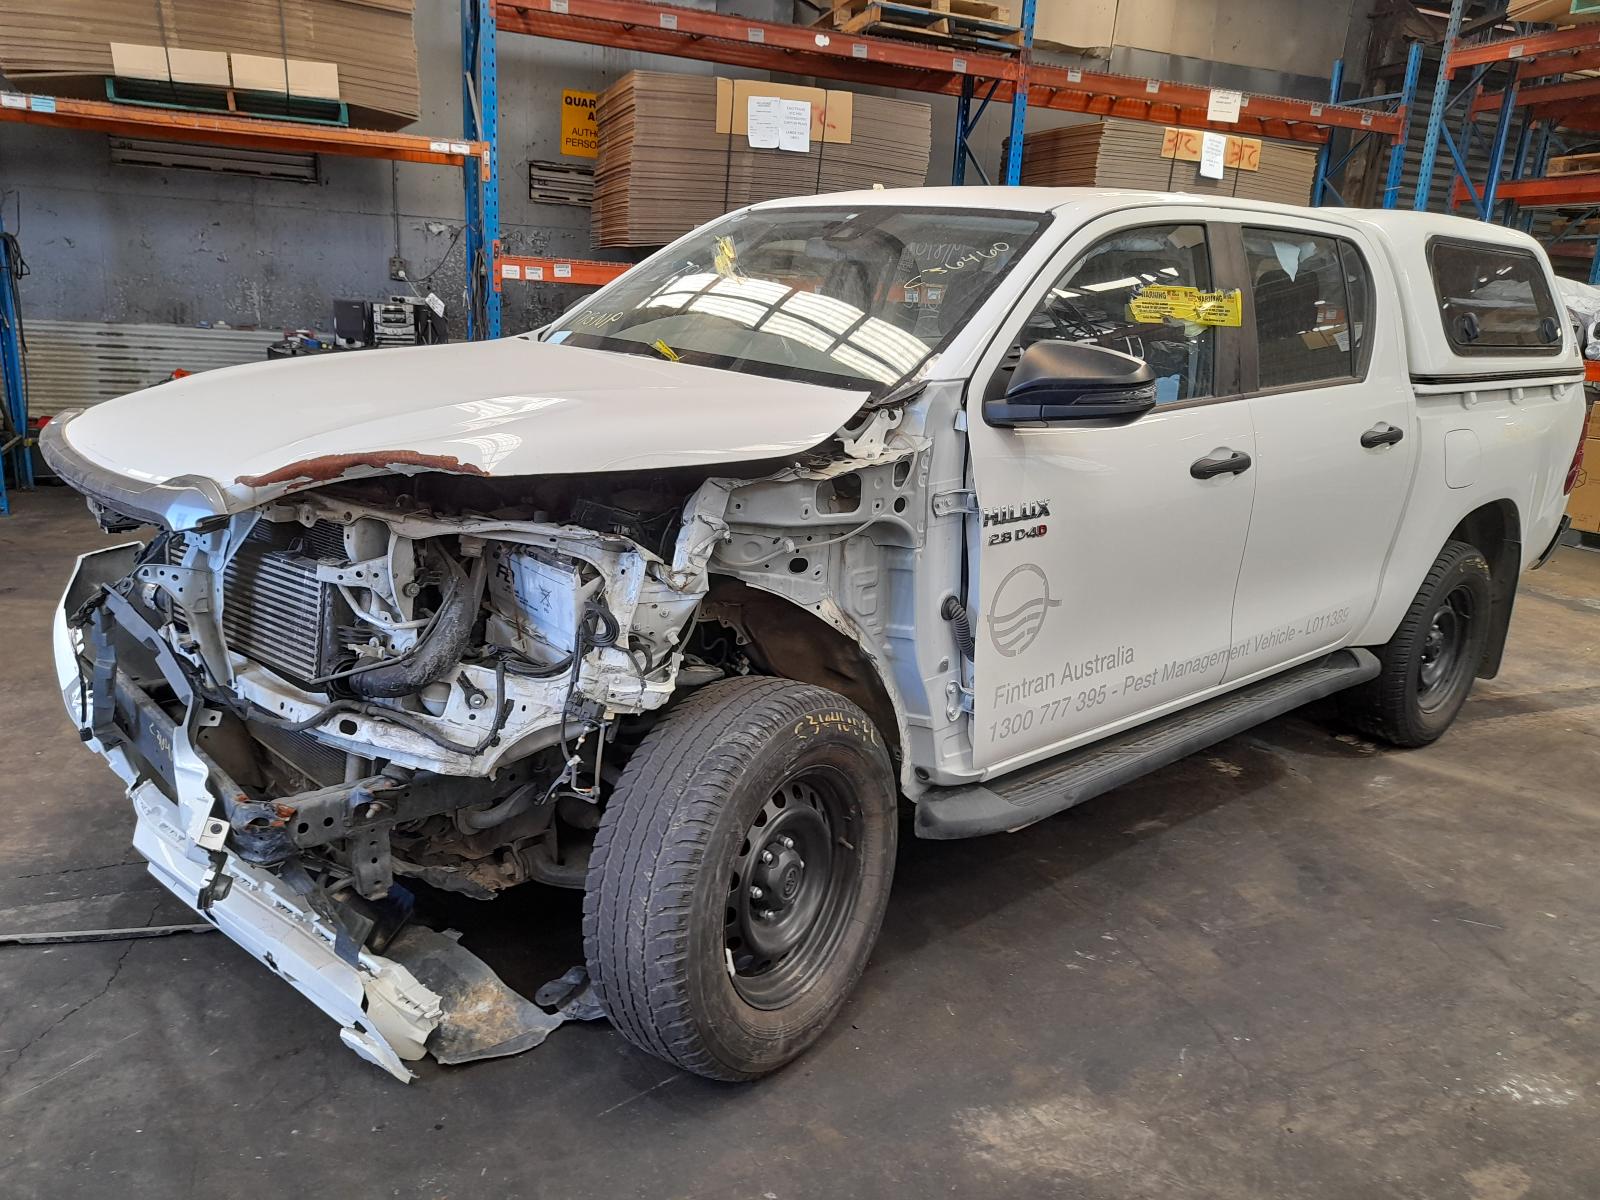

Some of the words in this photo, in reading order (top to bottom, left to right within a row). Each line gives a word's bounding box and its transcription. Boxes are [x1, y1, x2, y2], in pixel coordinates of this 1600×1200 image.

[565, 96, 597, 109] QUAR
[587, 112, 598, 121] A
[565, 138, 598, 149] PERSO
[982, 499, 1050, 528] HILUX
[989, 709, 1034, 743] 1300
[1040, 695, 1072, 725] 777
[1075, 684, 1107, 713] 395
[1122, 667, 1159, 697] Pest
[1161, 639, 1250, 682] Management
[1254, 625, 1296, 652] Vehicle
[993, 672, 1055, 709] Fintran
[1060, 645, 1135, 686] Australia
